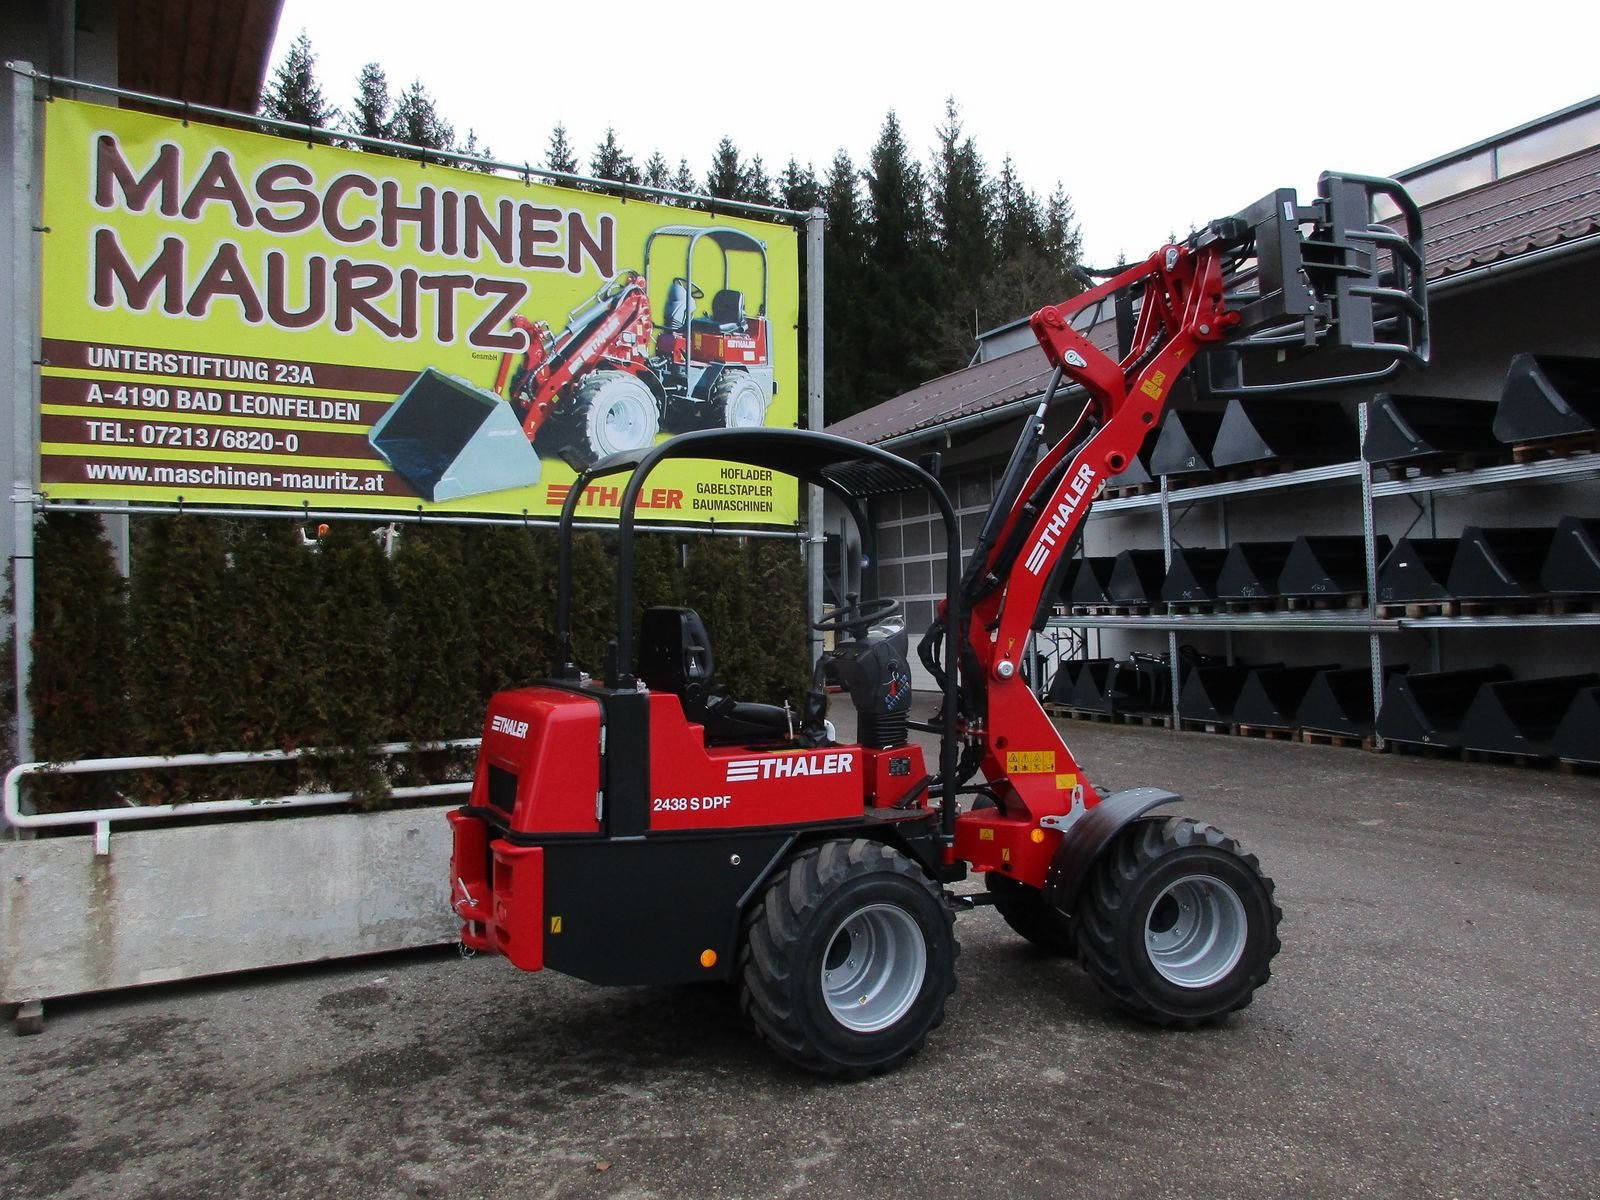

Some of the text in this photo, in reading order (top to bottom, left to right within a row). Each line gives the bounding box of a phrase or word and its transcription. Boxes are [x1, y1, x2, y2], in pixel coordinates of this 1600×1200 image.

[95, 134, 615, 279] MASCHINEN
[93, 228, 527, 350] MAURITZ
[87, 347, 315, 385] UNTERSTIFTUNG 23A
[86, 383, 360, 421] A-4190 BAD LEONFELDEN
[86, 421, 299, 452] TEL: 07213/6820-0
[86, 463, 384, 492] www.maschinen-mauritz.at
[720, 468, 773, 481] HOFLADER
[696, 482, 773, 497] GABELSTAPLER
[693, 499, 773, 512] BAUMASCHINEN
[1040, 463, 1096, 546] THALER
[499, 717, 529, 739] THALER
[758, 753, 853, 779] THALER
[653, 796, 731, 811] 2438 S DPF
